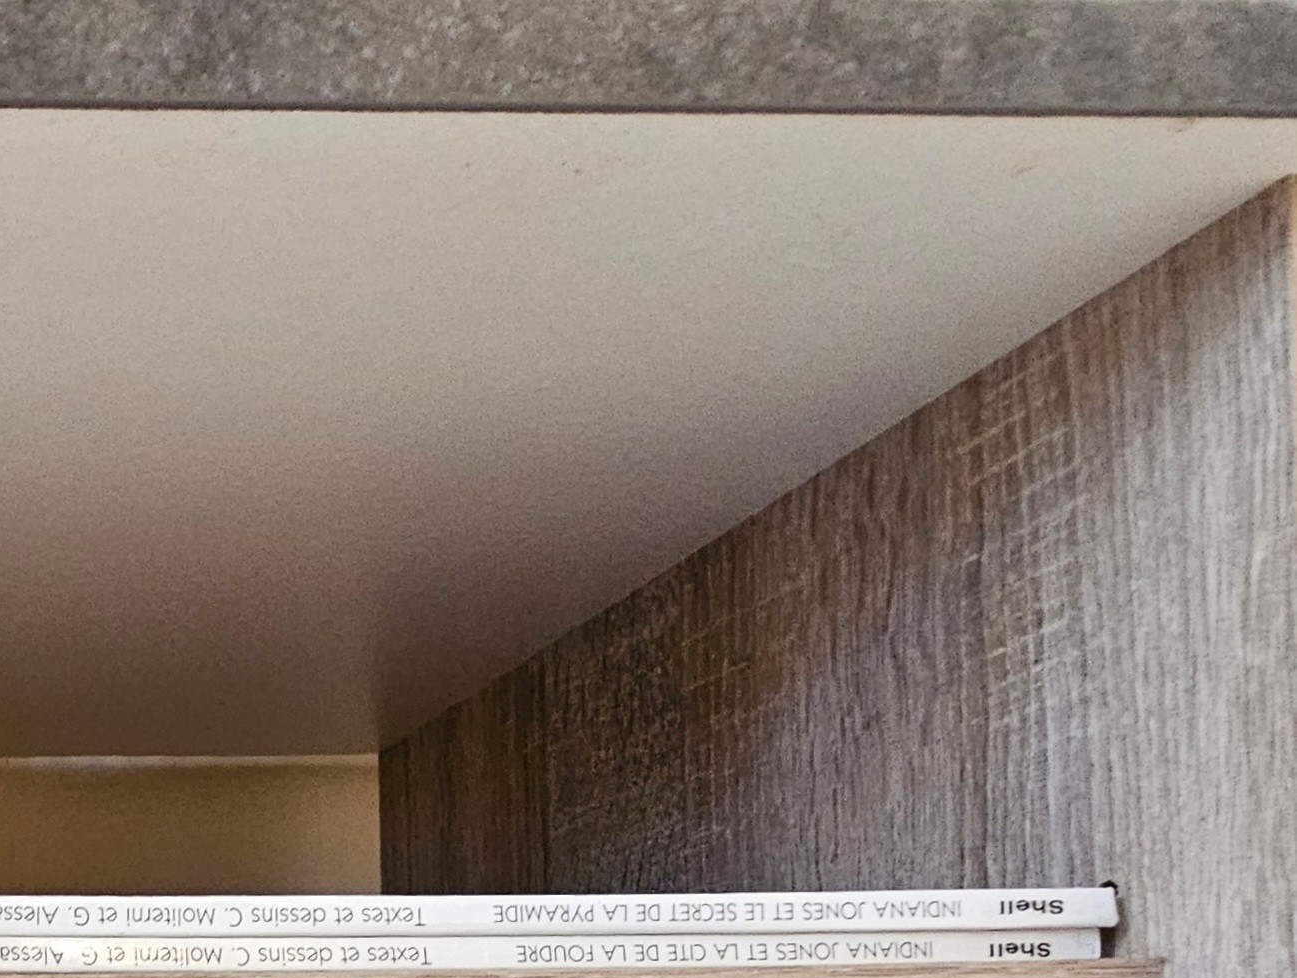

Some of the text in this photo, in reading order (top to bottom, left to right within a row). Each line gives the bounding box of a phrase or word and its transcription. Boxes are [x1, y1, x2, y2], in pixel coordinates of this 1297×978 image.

[67, 905, 90, 927] G.
[98, 906, 117, 924] et
[127, 906, 216, 928] Moliterni
[224, 907, 243, 928] C.
[251, 906, 326, 927] dessins
[335, 906, 354, 923] et
[361, 906, 427, 927] Textes
[493, 899, 1064, 923] Shell INDIANA JONES ET LE SECRET DE LA PYRAMIDE
[106, 947, 125, 964] et
[134, 946, 222, 967] Moliterni
[230, 947, 250, 967] C.
[258, 947, 333, 967] dessins
[341, 947, 360, 964] et
[367, 947, 433, 966] Textes
[516, 941, 1051, 963] Shell INDIANA JONES ET LA CITE DE LA FOUDRE
